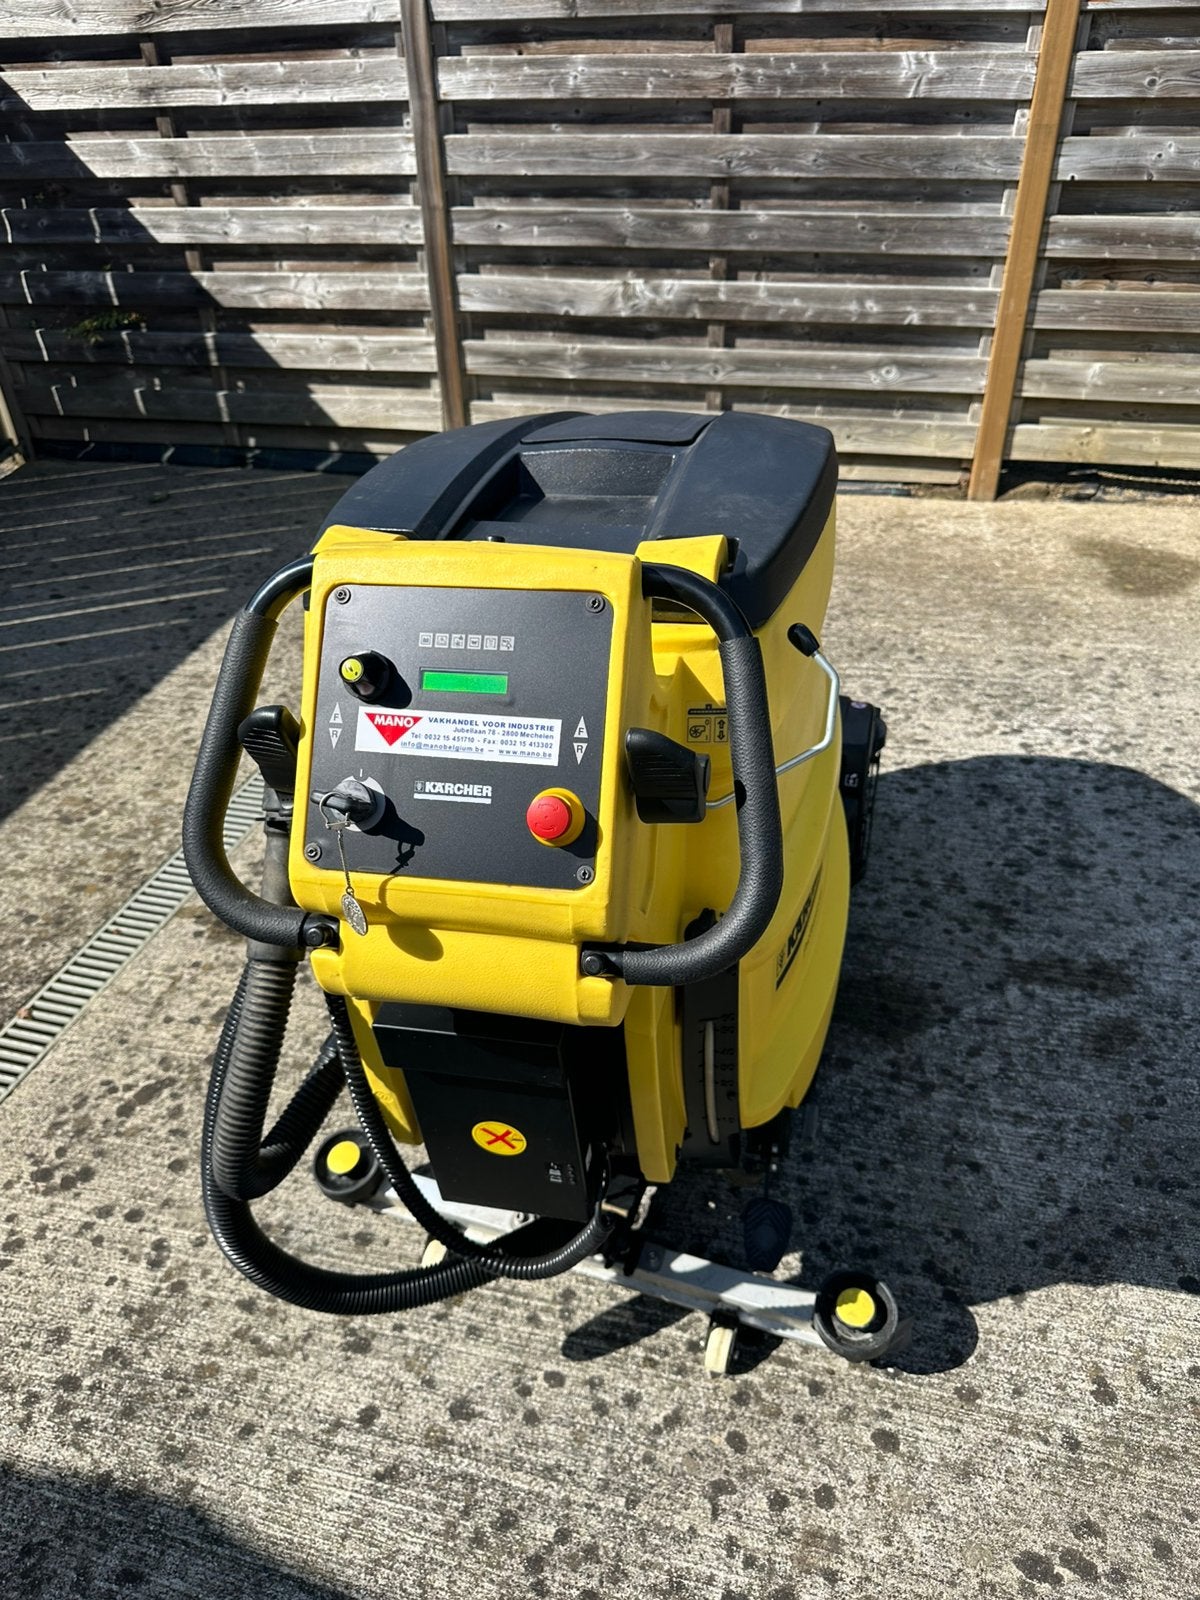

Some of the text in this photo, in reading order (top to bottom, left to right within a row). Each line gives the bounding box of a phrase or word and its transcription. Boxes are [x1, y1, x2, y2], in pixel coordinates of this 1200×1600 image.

[374, 714, 414, 728] MANO
[428, 717, 555, 732] VAKHANDEL VOOR INDUSTRIE
[453, 726, 486, 735] Jubellaan
[502, 729, 519, 737] 2800
[520, 731, 554, 740] Mechelen
[578, 727, 585, 736] F
[424, 733, 441, 741] 0032
[528, 741, 553, 749] 413302
[400, 741, 484, 753] info@manobelgium.be
[499, 748, 552, 758] www.mano.be
[576, 744, 584, 754] R
[425, 781, 492, 797] KÄRCHER
